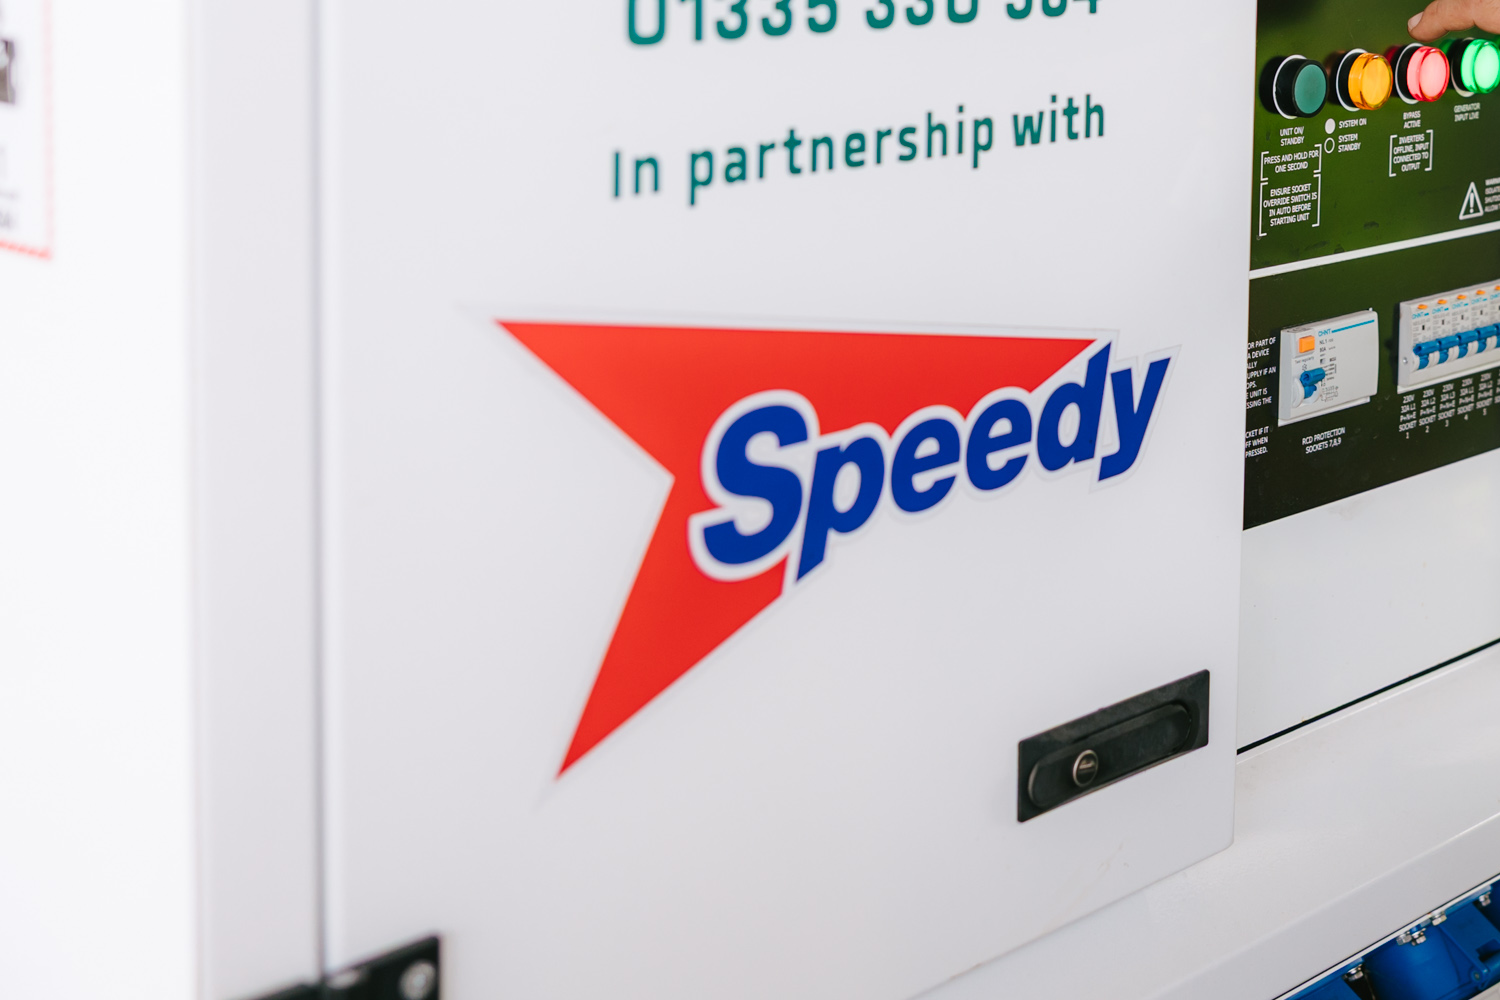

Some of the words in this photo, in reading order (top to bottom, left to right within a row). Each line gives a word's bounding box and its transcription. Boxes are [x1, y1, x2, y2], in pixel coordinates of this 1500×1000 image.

[1453, 102, 1481, 113] GENERATOR
[1403, 110, 1421, 120] BYPASS
[1454, 113, 1469, 122] INPUT
[1469, 111, 1479, 120] LIVE
[1338, 119, 1358, 129] SYSTEM
[1359, 118, 1367, 126] ON
[1403, 120, 1421, 129] ACTIVE
[1280, 128, 1293, 136] UNIT
[1280, 136, 1305, 146] STANDBY
[1338, 133, 1358, 143] SYSTEM
[1399, 134, 1425, 144] INVERTERS
[613, 150, 660, 199] In
[689, 104, 994, 206] partnership
[1011, 94, 1105, 149] with
[1338, 142, 1361, 153] STANDBY
[1415, 142, 1429, 151] INPUT
[1264, 155, 1281, 165] PRESS
[1281, 154, 1293, 162] AND
[1294, 152, 1308, 160] HOLD
[1309, 150, 1319, 158] FOR
[1393, 152, 1421, 164] CONNECTED
[1422, 151, 1429, 159] TO
[1275, 164, 1287, 173] ONE
[1287, 161, 1308, 171] SECOND
[1401, 162, 1421, 172] OUTPUT
[1270, 186, 1291, 197] ENSURE
[1291, 183, 1312, 193] SOCKET
[1263, 197, 1290, 208] OVERRIDE
[1290, 193, 1310, 203] SWITCH
[1312, 192, 1318, 200] IS
[1269, 209, 1276, 217] IN
[1276, 206, 1291, 215] AUTO
[1292, 203, 1311, 213] BEFORE
[1270, 215, 1296, 227] STARTING
[1297, 213, 1310, 222] UNIT
[1255, 338, 1268, 348] PART
[1269, 336, 1276, 345] OF
[1252, 348, 1270, 359] DEVICE
[1263, 367, 1268, 375] IF
[1268, 366, 1277, 374] AN
[1249, 388, 1262, 398] UNIT
[1262, 387, 1268, 395] IS
[1262, 395, 1272, 405] THE
[1403, 394, 1415, 404] 230V
[1476, 397, 1493, 409] SOCKET
[1438, 409, 1455, 420] SOCKET
[1457, 403, 1474, 415] SOCKET
[1419, 414, 1437, 426] SOCKET
[1258, 427, 1264, 435] IF
[1264, 425, 1269, 434] IT
[1399, 420, 1417, 432] SOCKET
[1425, 425, 1429, 433] 2
[1252, 436, 1268, 446] WHEN
[1302, 436, 1313, 445] RCD
[1314, 427, 1345, 442] PROTECTION
[1305, 440, 1329, 454] SOCKETS
[702, 340, 1172, 584] Speedy
